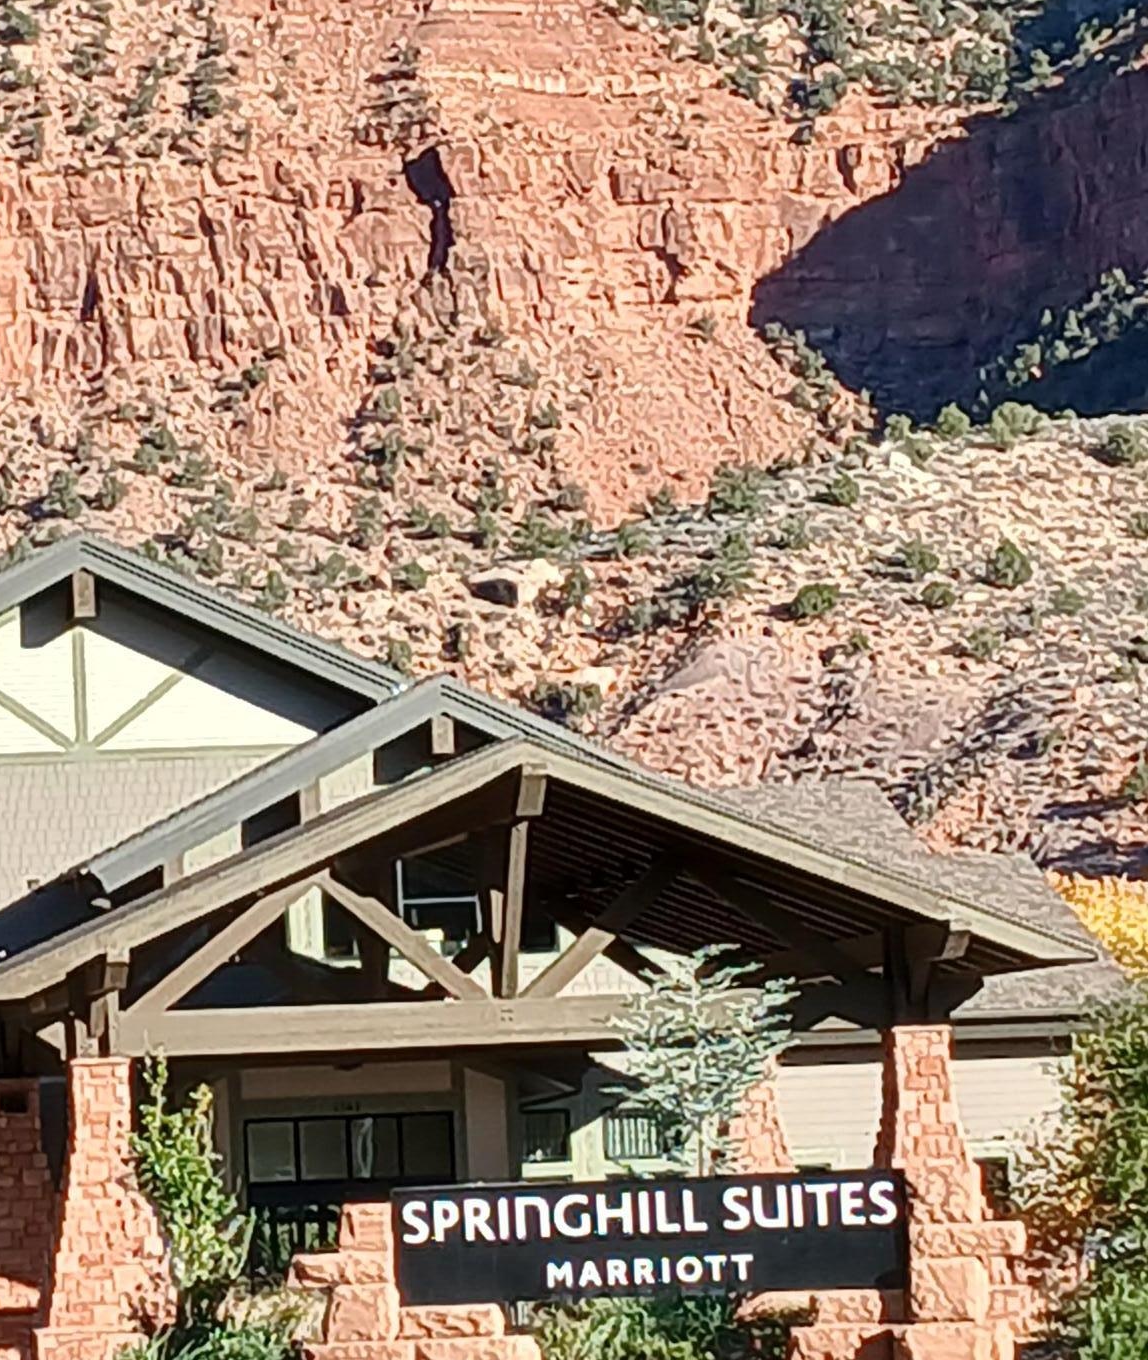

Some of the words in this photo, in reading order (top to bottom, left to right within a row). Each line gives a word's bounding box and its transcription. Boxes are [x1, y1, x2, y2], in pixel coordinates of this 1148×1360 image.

[402, 1189, 708, 1244] SPRINGHILL
[722, 1180, 898, 1232] SUITES
[546, 1253, 754, 1289] MARRIOTT
